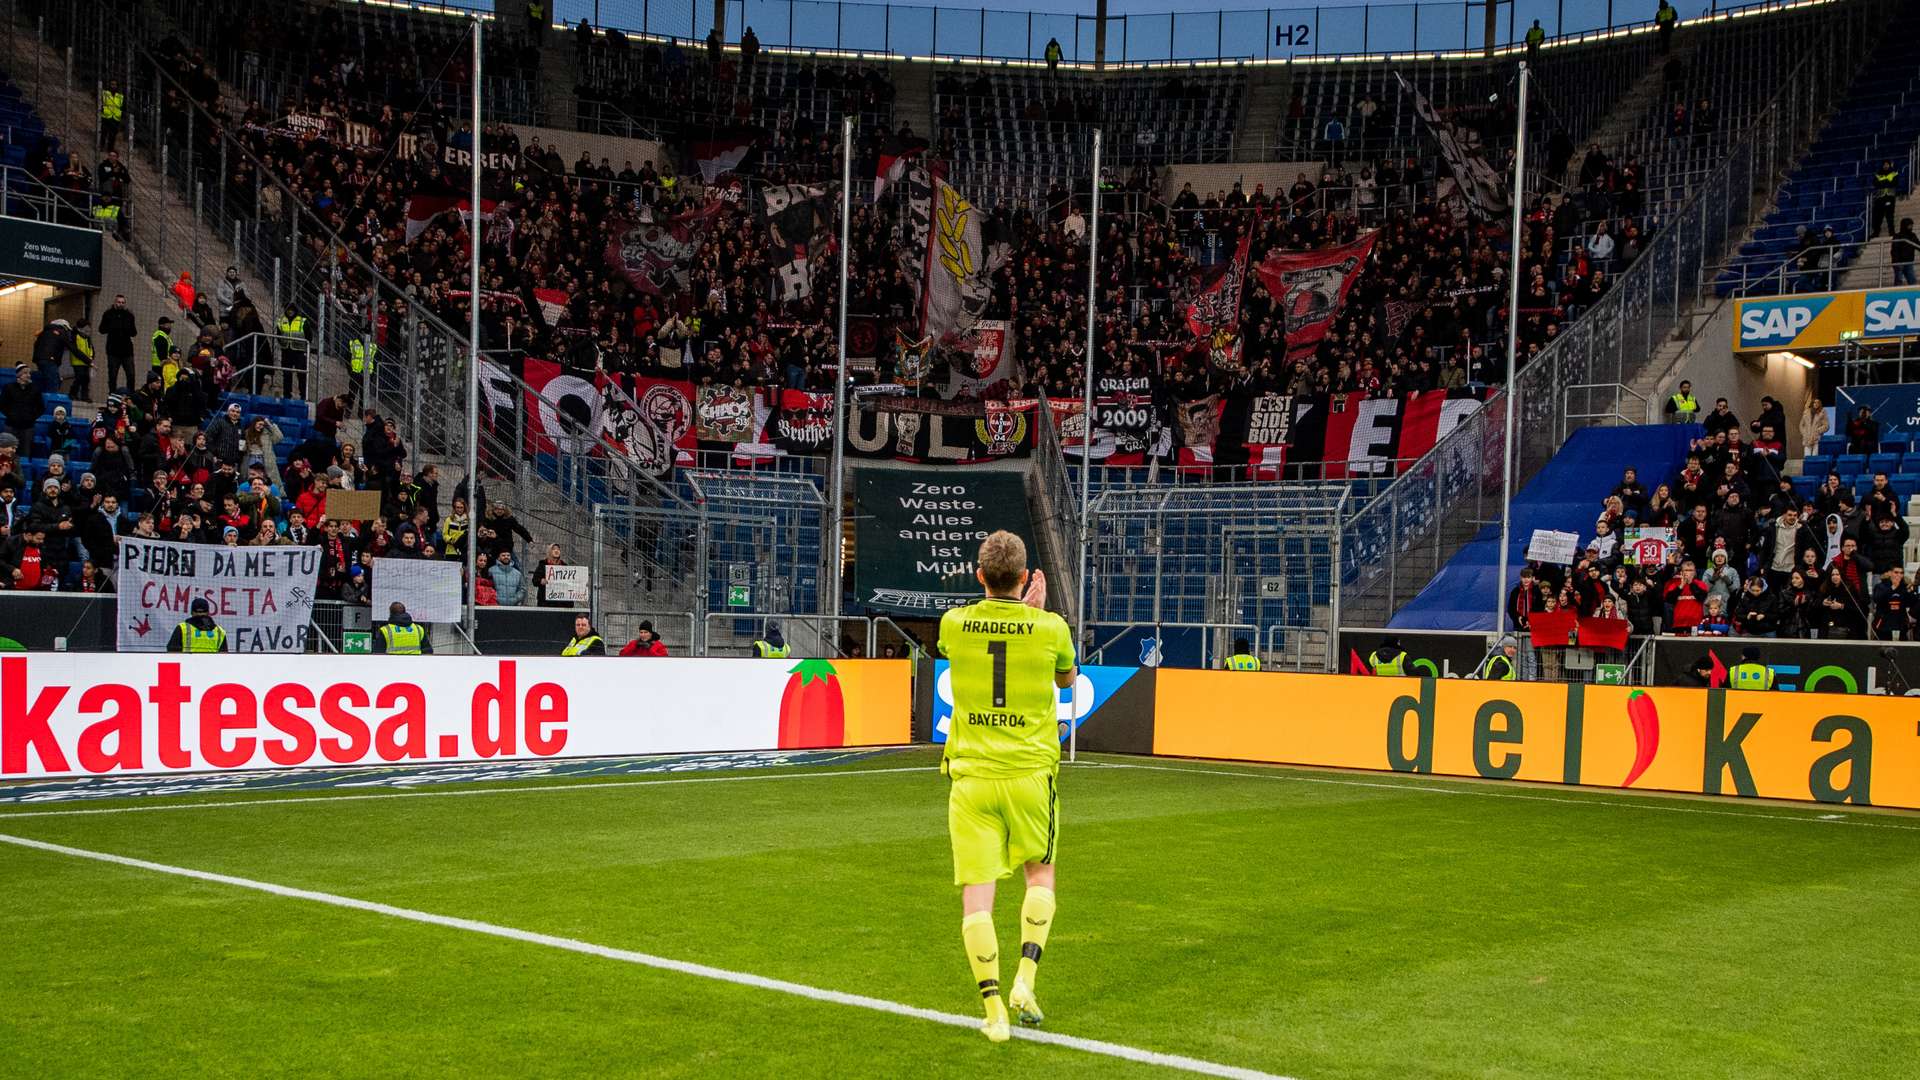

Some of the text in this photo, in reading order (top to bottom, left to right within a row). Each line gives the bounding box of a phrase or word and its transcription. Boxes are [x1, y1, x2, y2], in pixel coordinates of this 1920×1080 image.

[1275, 25, 1310, 46] H2
[24, 241, 39, 251] Zero
[23, 251, 40, 261] Alles
[41, 255, 64, 264] andere
[65, 257, 74, 266] ist
[1865, 298, 1920, 332] SA
[1741, 307, 1812, 341] SAP
[1103, 409, 1148, 427] 2009
[1250, 412, 1290, 428] SIDE
[994, 434, 1006, 442] 04
[1248, 428, 1288, 444] BOYZ
[912, 482, 965, 495] Zero
[899, 497, 983, 510] Waste.
[912, 514, 973, 525] Alles
[899, 529, 989, 541] andere
[931, 545, 962, 557] ist
[1643, 544, 1657, 557] 30
[213, 551, 236, 577] DA
[245, 552, 275, 577] ME
[283, 550, 316, 576] TU
[1267, 581, 1280, 593] G2
[141, 581, 277, 617] CAMSETA
[354, 613, 361, 624] F
[962, 620, 1035, 635] HRADECKY
[987, 640, 1007, 708] 1
[2, 657, 569, 775] katessa.de
